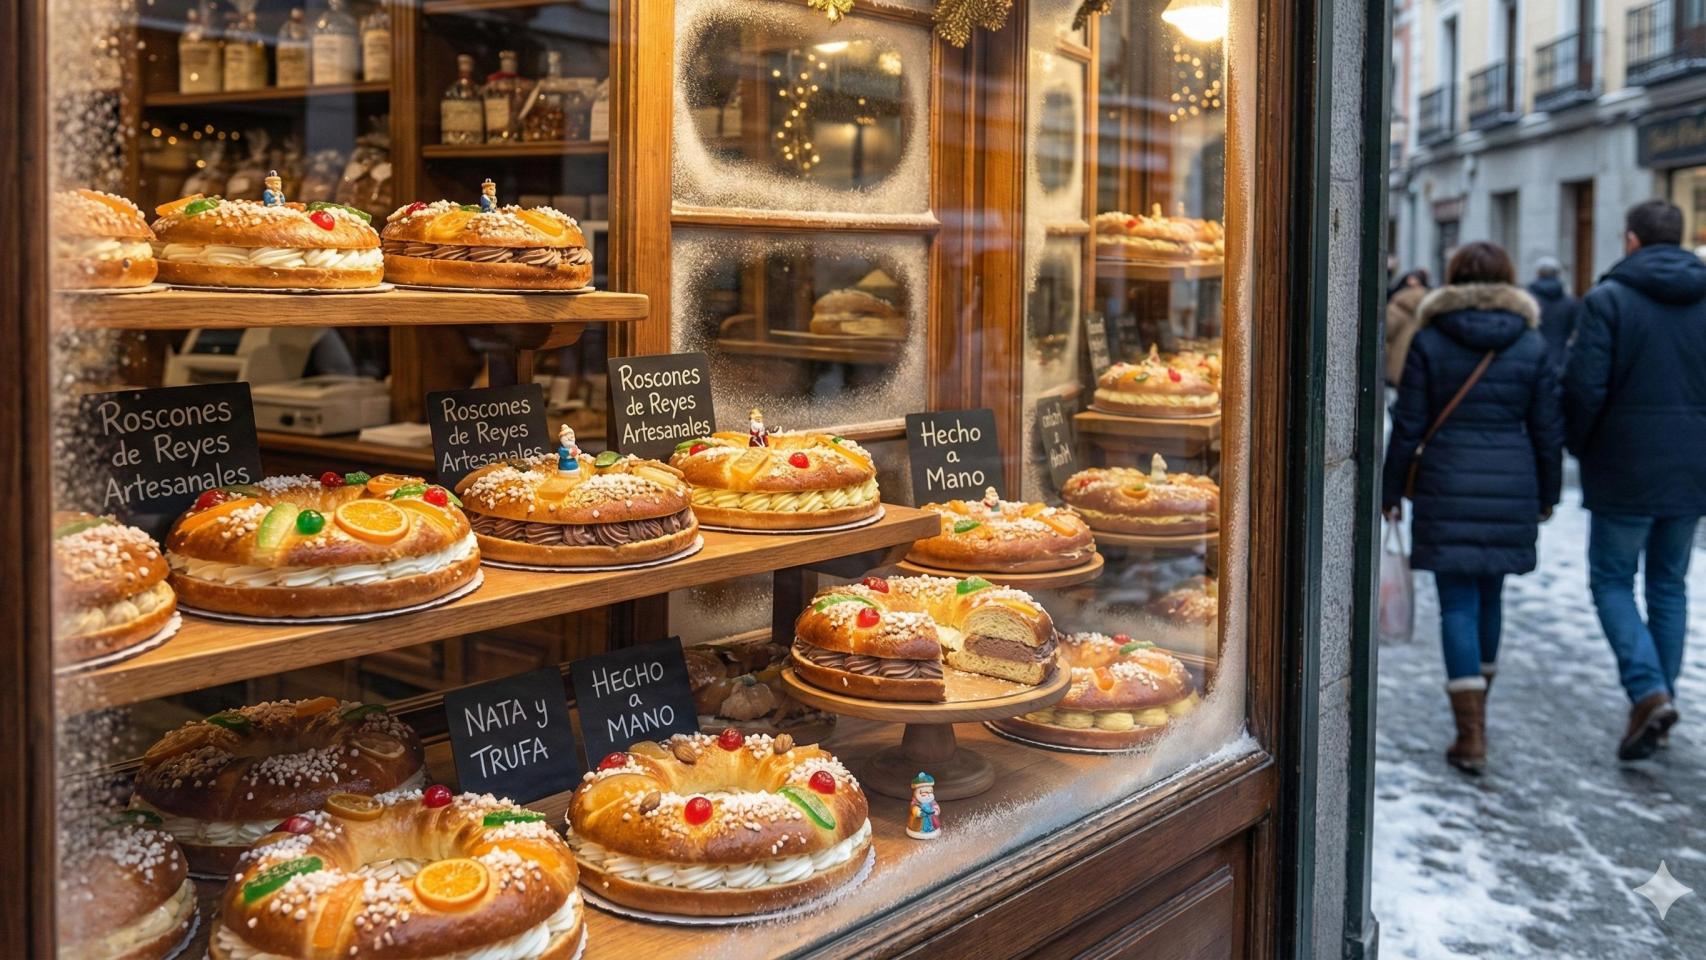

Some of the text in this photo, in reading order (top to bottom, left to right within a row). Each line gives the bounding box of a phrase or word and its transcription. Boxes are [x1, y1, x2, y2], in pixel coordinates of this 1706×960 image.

[618, 364, 701, 391] Roscones
[97, 400, 232, 436] Roscones
[441, 397, 531, 422] Roscones
[626, 392, 696, 419] de Reyes
[448, 421, 529, 447] de Reyes
[622, 415, 711, 445] Artesanales
[920, 419, 981, 447] Hecho
[112, 433, 230, 468] de Reyes
[946, 450, 960, 463] a
[103, 462, 250, 508] Artesanales
[926, 466, 985, 491] Mano
[591, 661, 664, 699] HECHO
[628, 693, 643, 708] a
[464, 698, 528, 737] NATA
[607, 704, 675, 743] MANO
[470, 736, 549, 779] TRUFA
